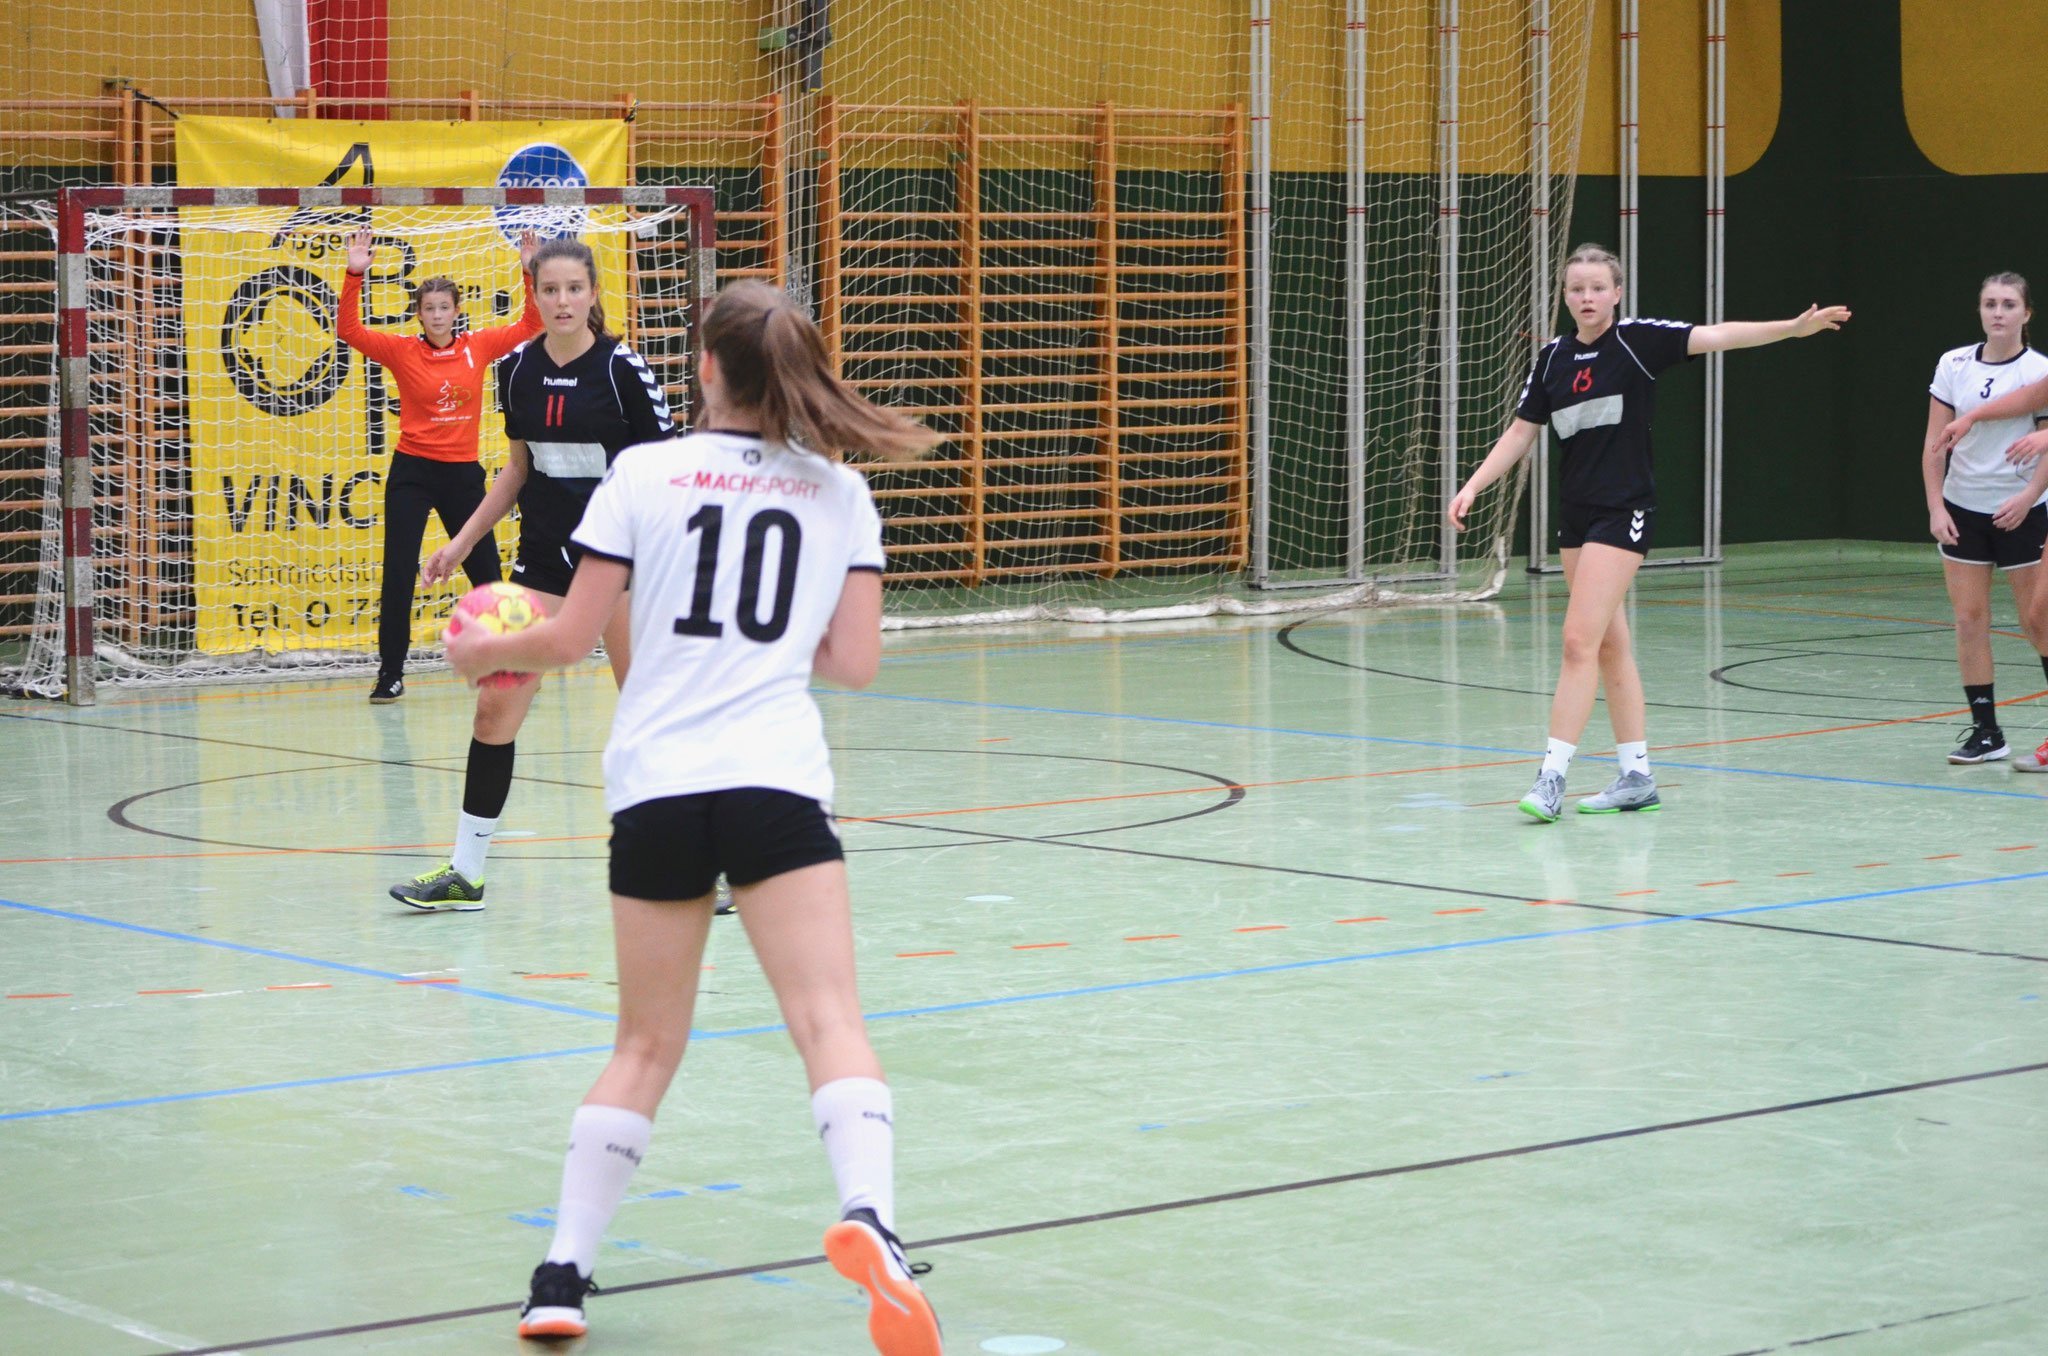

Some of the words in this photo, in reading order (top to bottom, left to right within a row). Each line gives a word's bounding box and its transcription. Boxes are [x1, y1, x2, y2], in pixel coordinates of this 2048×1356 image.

[463, 346, 474, 369] 1
[543, 376, 578, 387] hummel
[1572, 367, 1593, 393] 13
[1980, 378, 1995, 399] 3
[545, 394, 565, 427] 11
[693, 470, 821, 500] MACHSPORT
[222, 471, 382, 533] VINC
[227, 556, 383, 587] Schmiedstr
[673, 504, 802, 643] 10
[229, 603, 291, 631] Tel.
